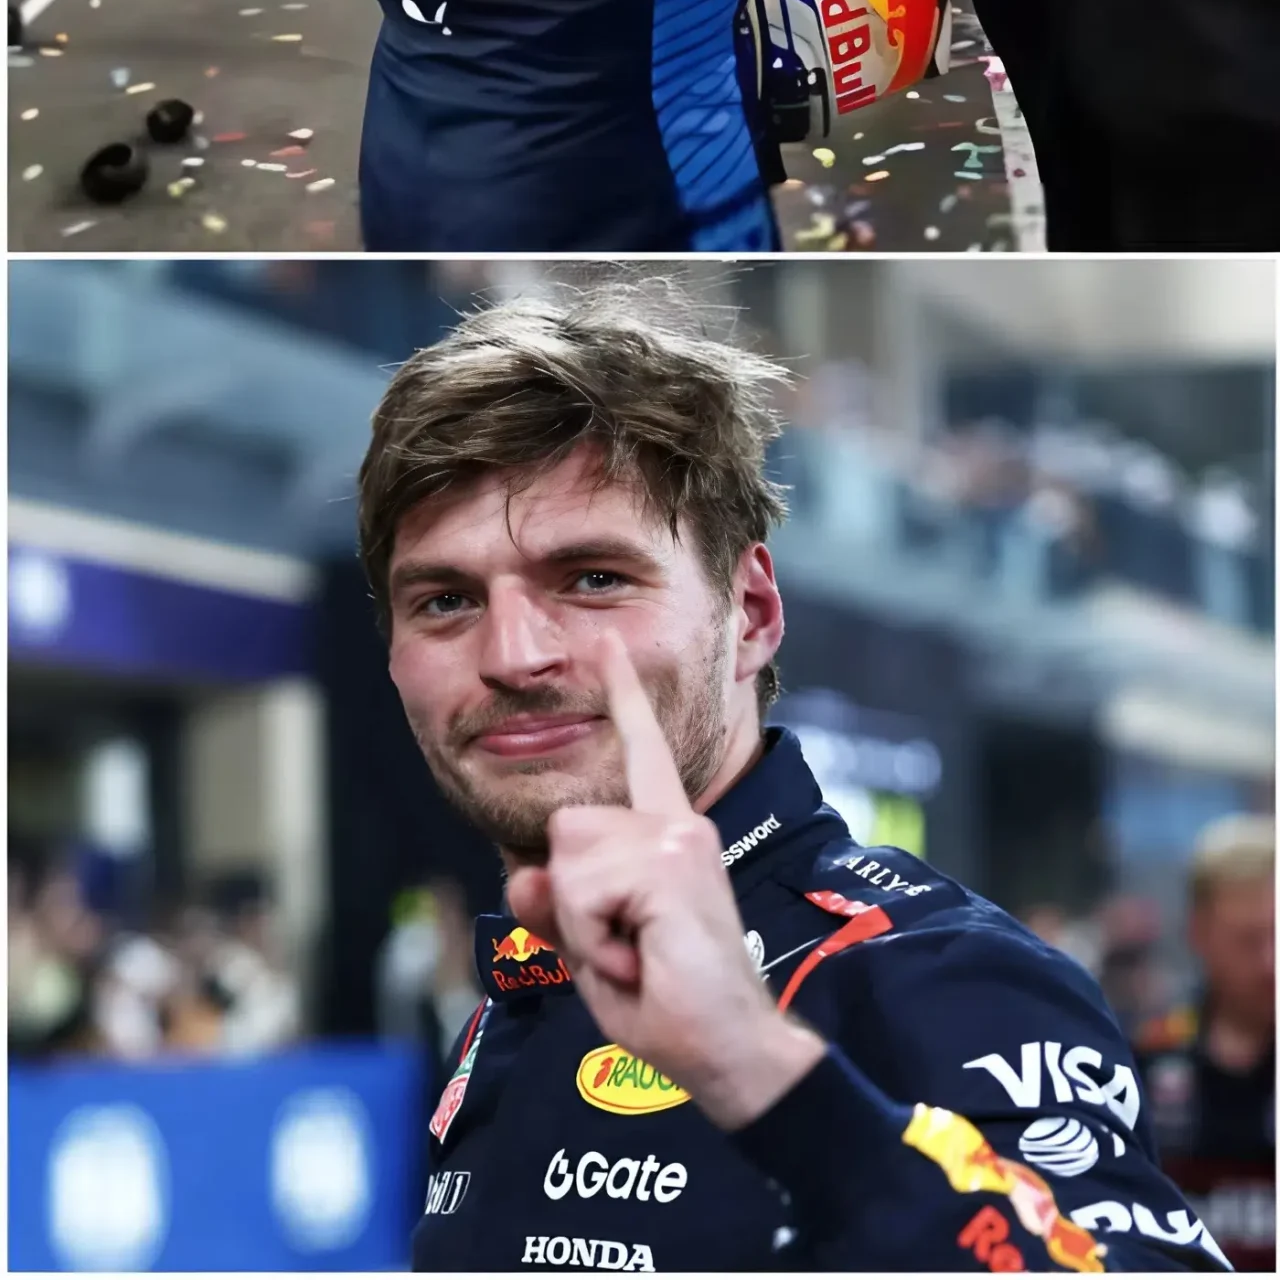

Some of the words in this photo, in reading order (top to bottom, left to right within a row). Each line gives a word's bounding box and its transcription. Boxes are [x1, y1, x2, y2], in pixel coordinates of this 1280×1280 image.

[962, 1041, 1140, 1131] VISA
[576, 1150, 688, 1203] Gate
[521, 1235, 656, 1273] HONDA
